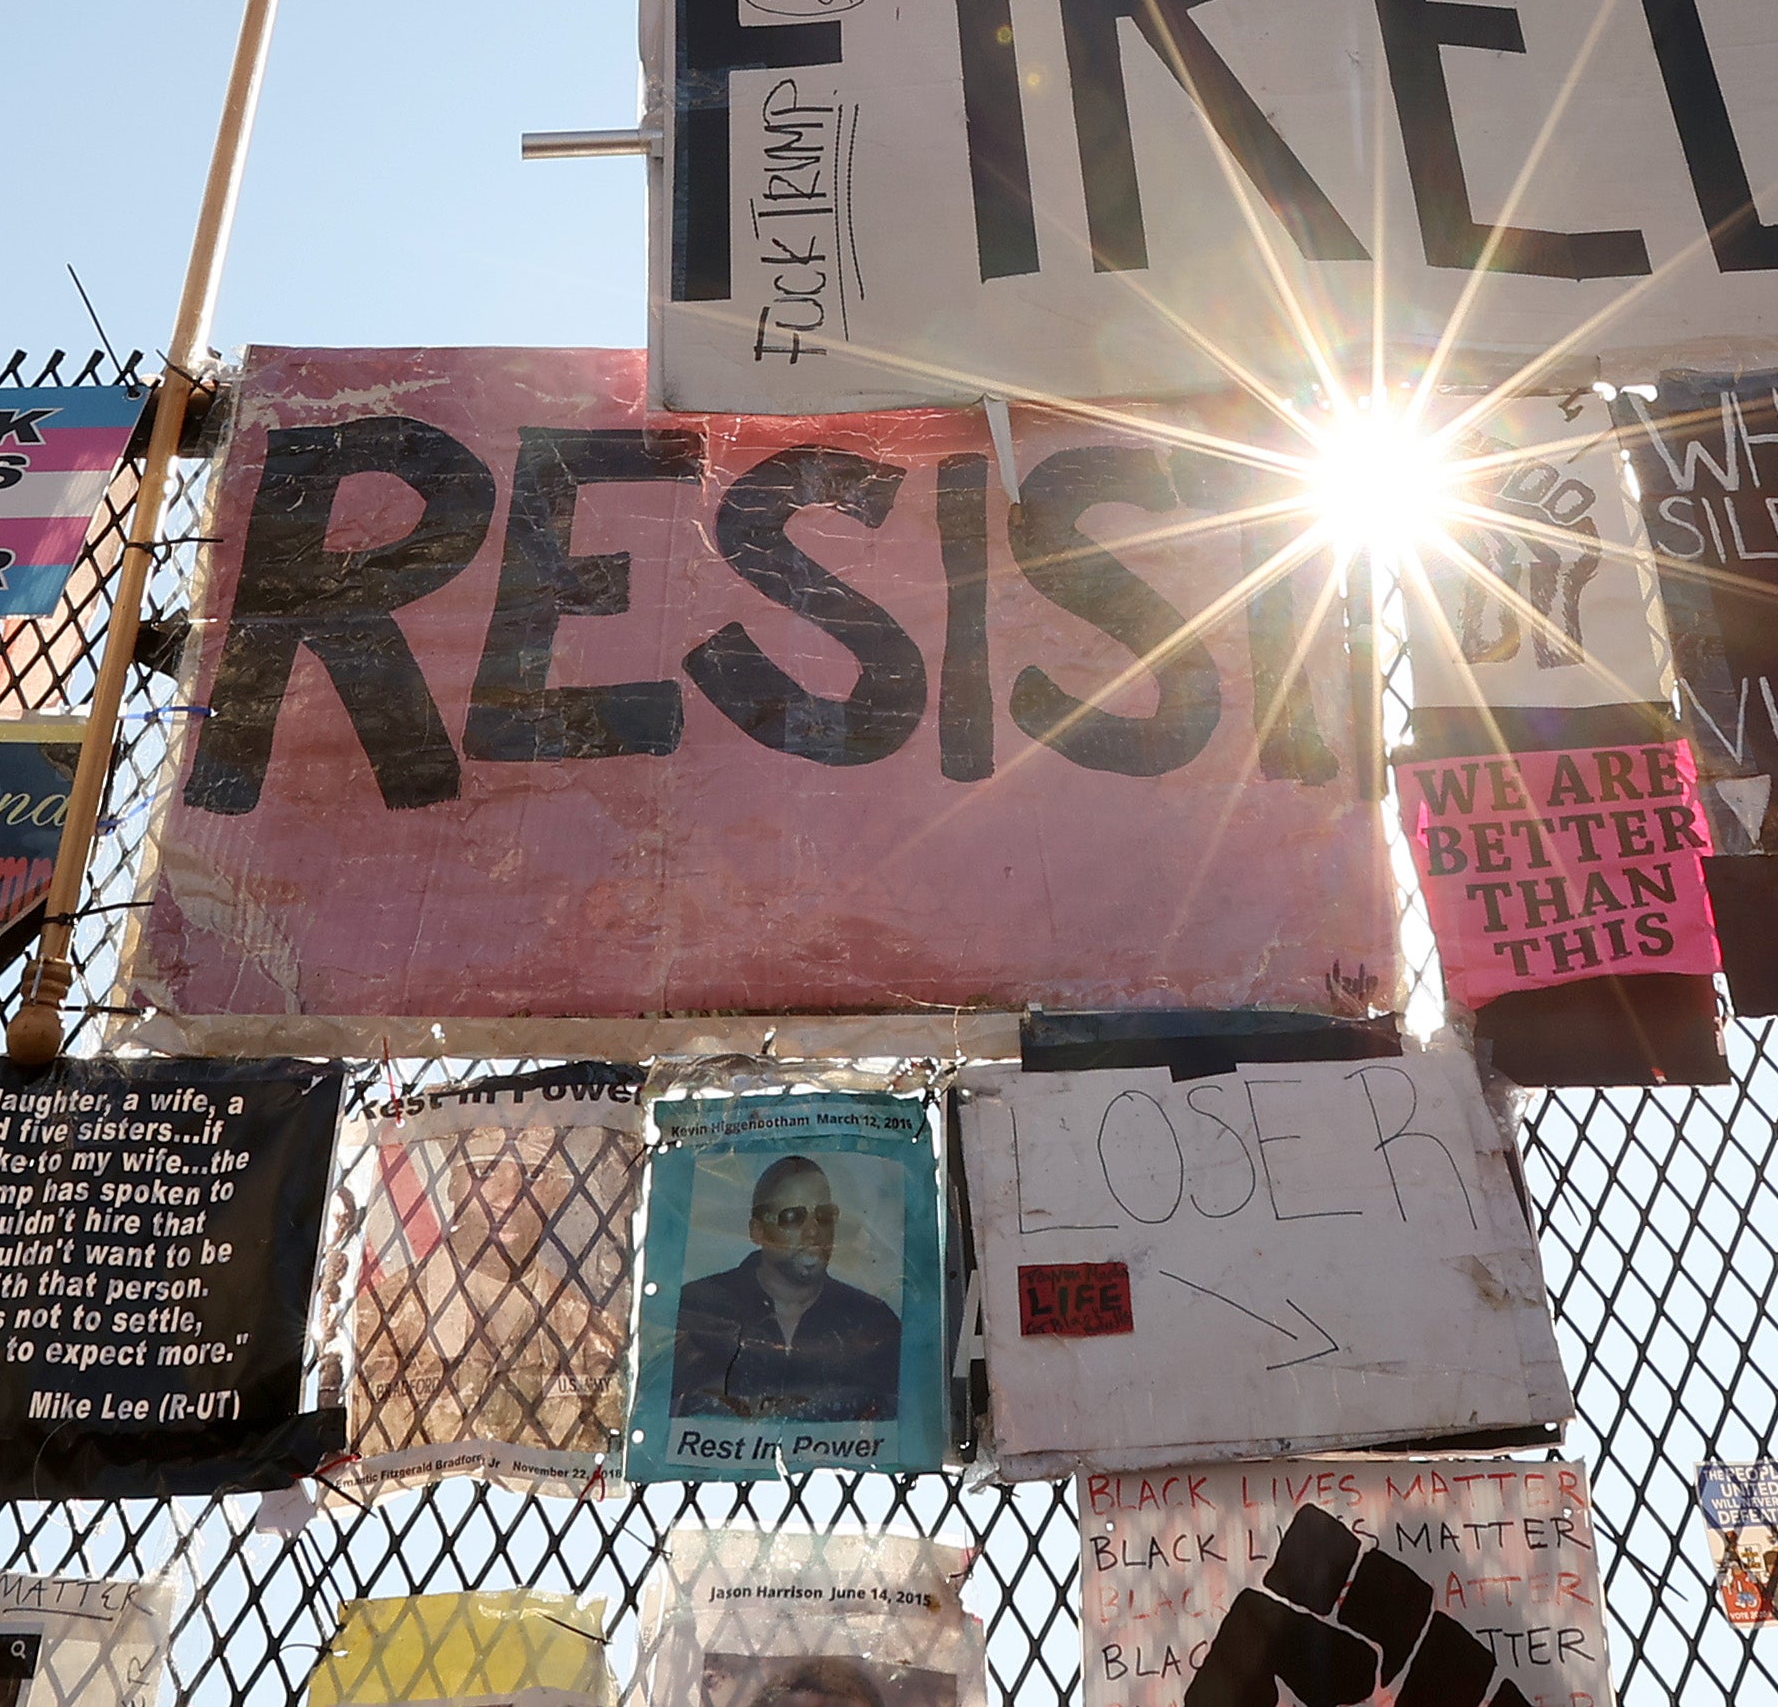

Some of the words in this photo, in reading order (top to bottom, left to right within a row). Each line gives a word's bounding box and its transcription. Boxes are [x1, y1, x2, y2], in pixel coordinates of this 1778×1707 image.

[751, 78, 834, 240] TRUMP
[754, 236, 827, 363] FUCK
[1412, 761, 1523, 815] WE
[1545, 746, 1684, 807] ARE
[1421, 804, 1707, 876] BETTER
[1467, 862, 1679, 934] THAN
[1494, 911, 1676, 978] THIS
[150, 1088, 216, 1117] wife,
[19, 1118, 68, 1144] five
[672, 1124, 707, 1138] Kevin
[816, 1114, 859, 1126] March
[863, 1115, 881, 1130] 12,
[72, 1151, 112, 1176] my
[1009, 1065, 1478, 1235] LOSER
[42, 1178, 90, 1203] has
[100, 1179, 200, 1208] spoken
[84, 1206, 141, 1234] hire
[152, 1209, 207, 1237] that
[45, 1340, 147, 1371] expect
[28, 1390, 92, 1419] Mike
[100, 1392, 150, 1420] Lee
[158, 1390, 240, 1423] (R-UT)
[676, 1428, 746, 1462] Rest
[513, 1460, 569, 1478] November
[572, 1468, 591, 1481] 22,
[1703, 1470, 1723, 1481] THE
[1087, 1475, 1216, 1515] BLACK
[1241, 1472, 1364, 1509] LIVES
[1385, 1471, 1585, 1508] MATTER
[1711, 1498, 1740, 1509] WILL
[1089, 1534, 1228, 1571] BLACK
[1395, 1517, 1592, 1552] MATTER
[709, 1586, 752, 1602] Jason
[756, 1586, 823, 1599] Harrison
[829, 1586, 865, 1601] June
[870, 1588, 892, 1604] 14,
[896, 1591, 932, 1606] 2015
